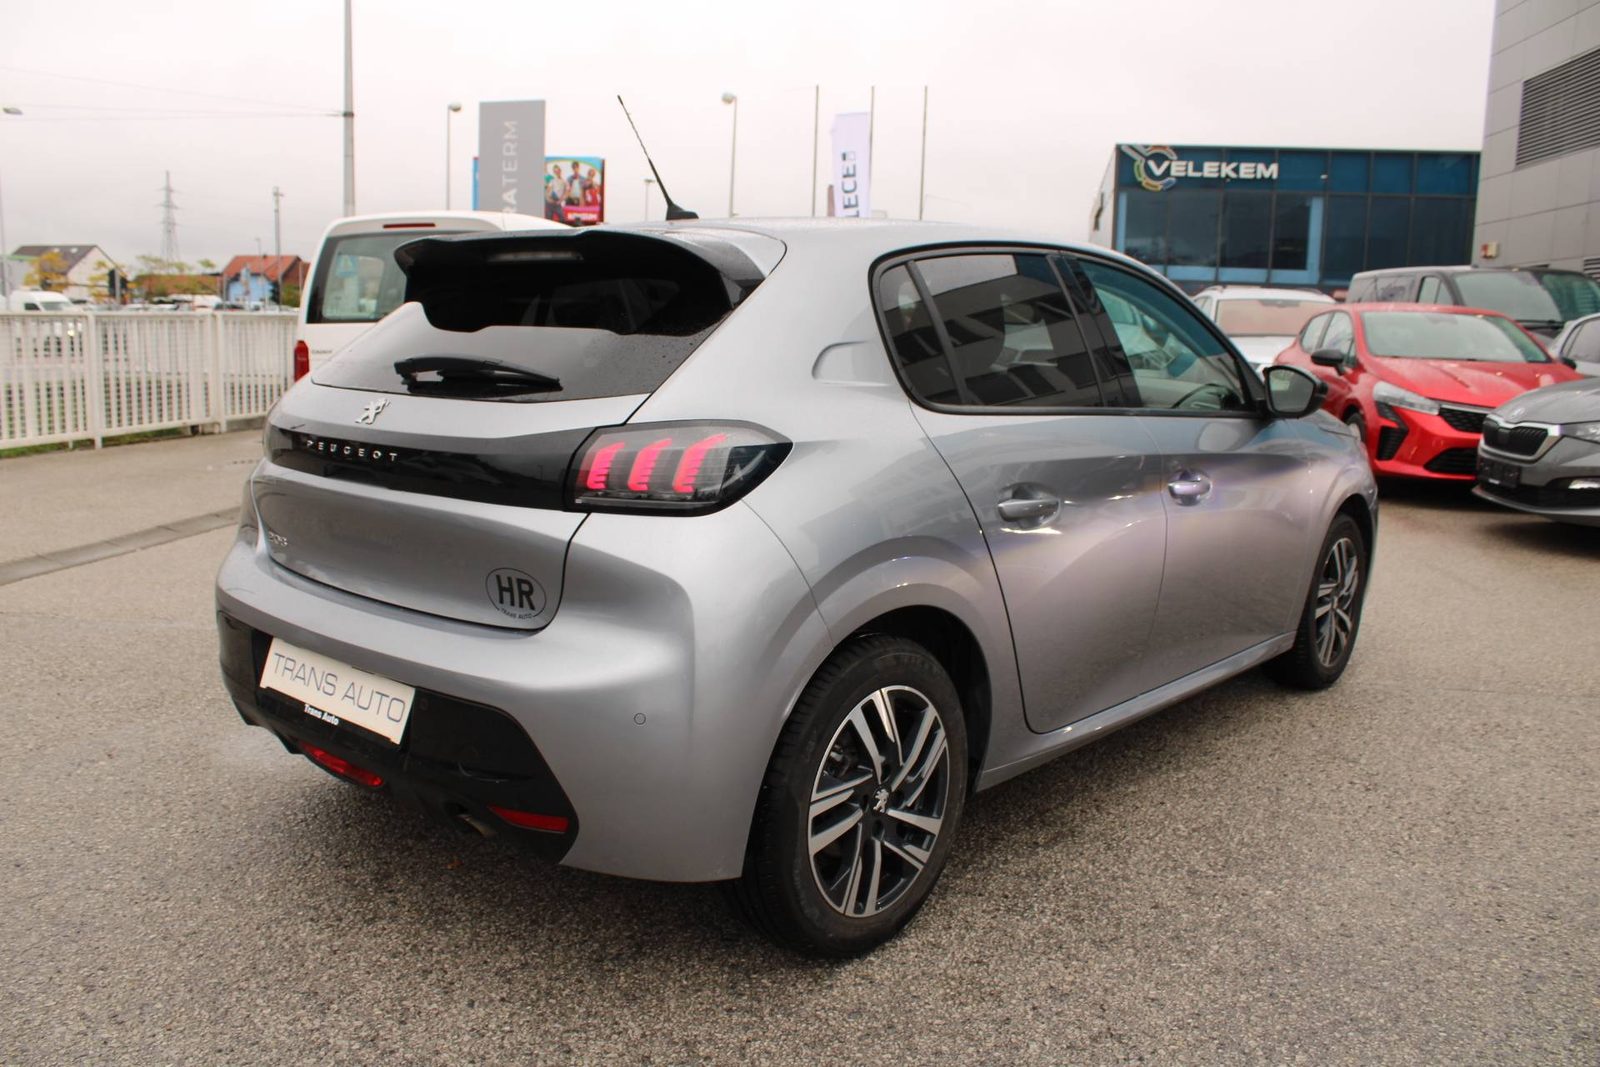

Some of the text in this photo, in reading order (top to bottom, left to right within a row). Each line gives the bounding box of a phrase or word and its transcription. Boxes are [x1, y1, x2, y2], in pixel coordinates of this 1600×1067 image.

[1147, 159, 1279, 180] VELEKEM
[306, 439, 398, 462] PEUGEOT
[495, 574, 536, 611] HR
[274, 652, 406, 723] TRANS AUTO
[303, 703, 340, 726] Trans Auto
